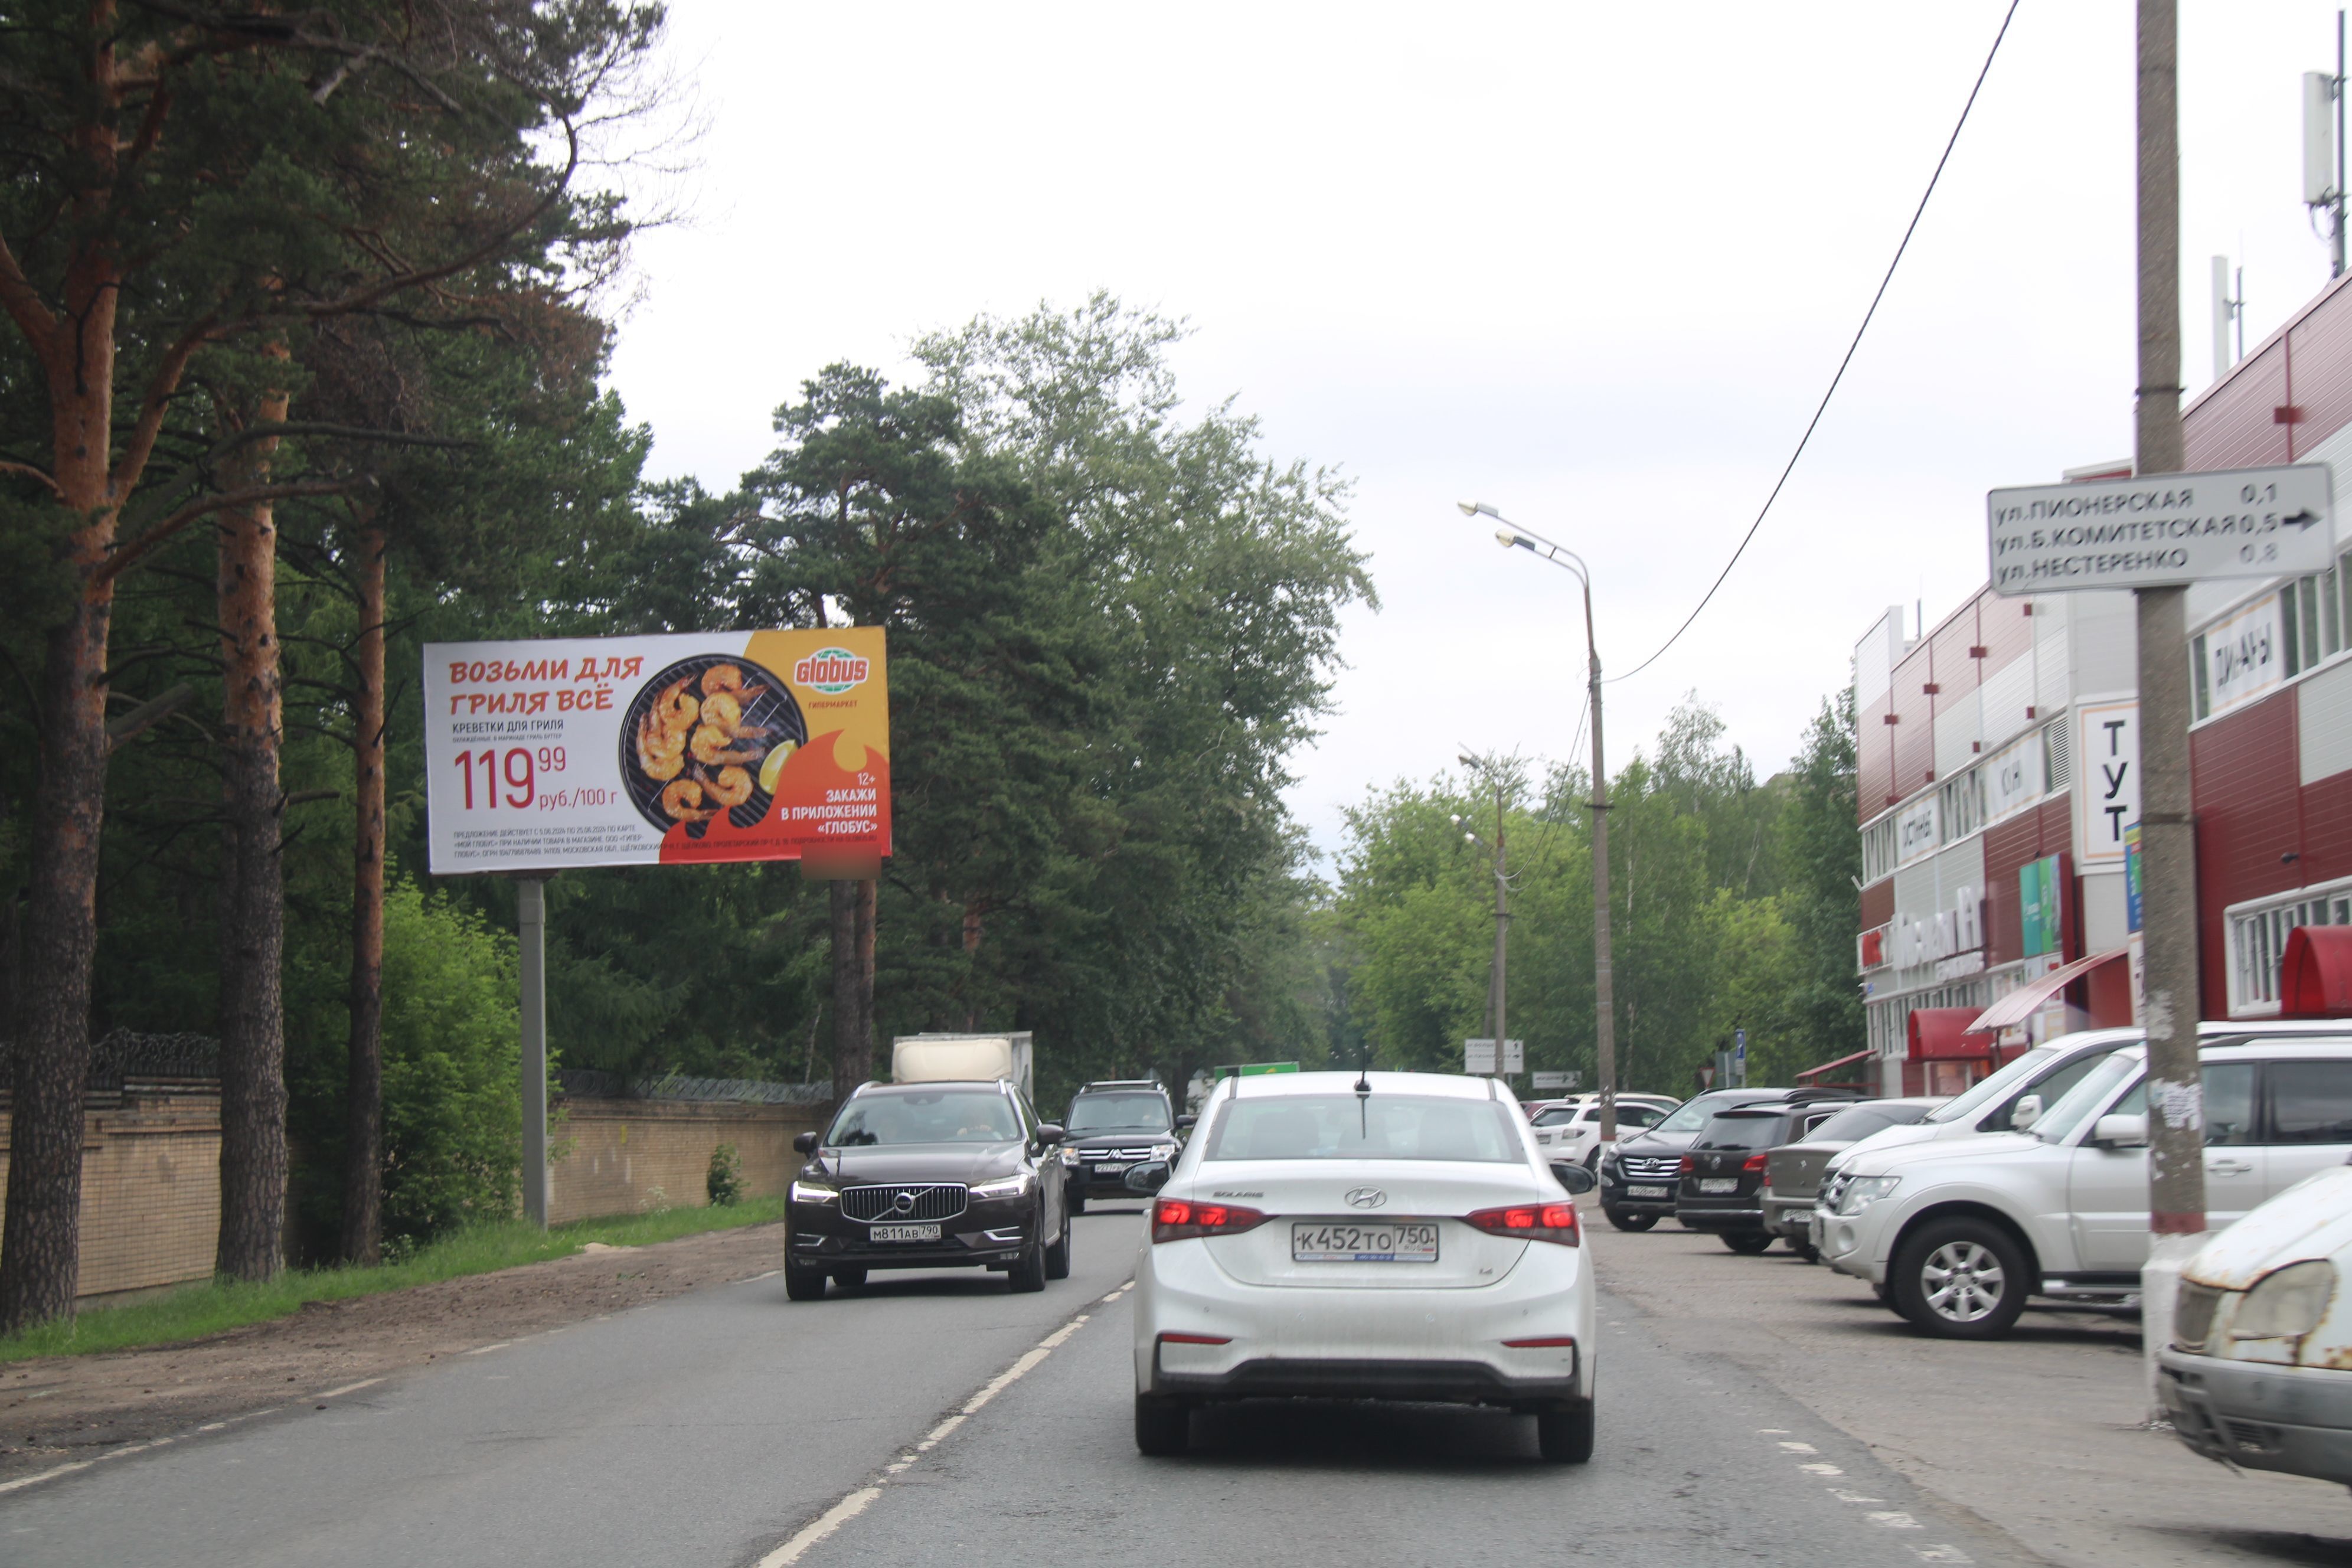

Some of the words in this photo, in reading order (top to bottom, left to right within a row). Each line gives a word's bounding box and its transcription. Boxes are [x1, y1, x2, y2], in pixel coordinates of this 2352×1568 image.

[2240, 482, 2276, 506] 0,1
[2239, 512, 2277, 536] 0,5
[449, 659, 569, 684] ВОЗЬМИ
[574, 656, 644, 683] ДЛЯ
[450, 691, 550, 716] ГРИЛЯ
[556, 682, 614, 711] ВСЁ
[808, 700, 858, 710] ГИПЕРМАРКЕТ
[453, 721, 504, 734] КРЕВЕТКИ
[507, 720, 528, 733] ДЛЯ
[531, 718, 564, 731] ГРИЛЯ
[455, 747, 535, 809] 119
[538, 746, 566, 772] 99
[858, 772, 876, 786] 12+
[2103, 719, 2128, 842] ТУТ
[540, 787, 605, 811] руб./100
[611, 791, 618, 805] г
[826, 788, 877, 803] ЗАКАЖИ
[781, 807, 789, 821] В
[792, 804, 877, 820] ПРИЛОЖЕНИИ
[454, 830, 498, 839] ПРЕДЛОЖЕНИЕ
[499, 828, 532, 837] ДЕЙСТВУЕТ
[818, 820, 878, 834] «ГЛОБУС»
[874, 1228, 919, 1239] М811АВ
[922, 1226, 938, 1234] 790
[1301, 1227, 1391, 1250] К452ТО
[1396, 1226, 1430, 1244] 750
